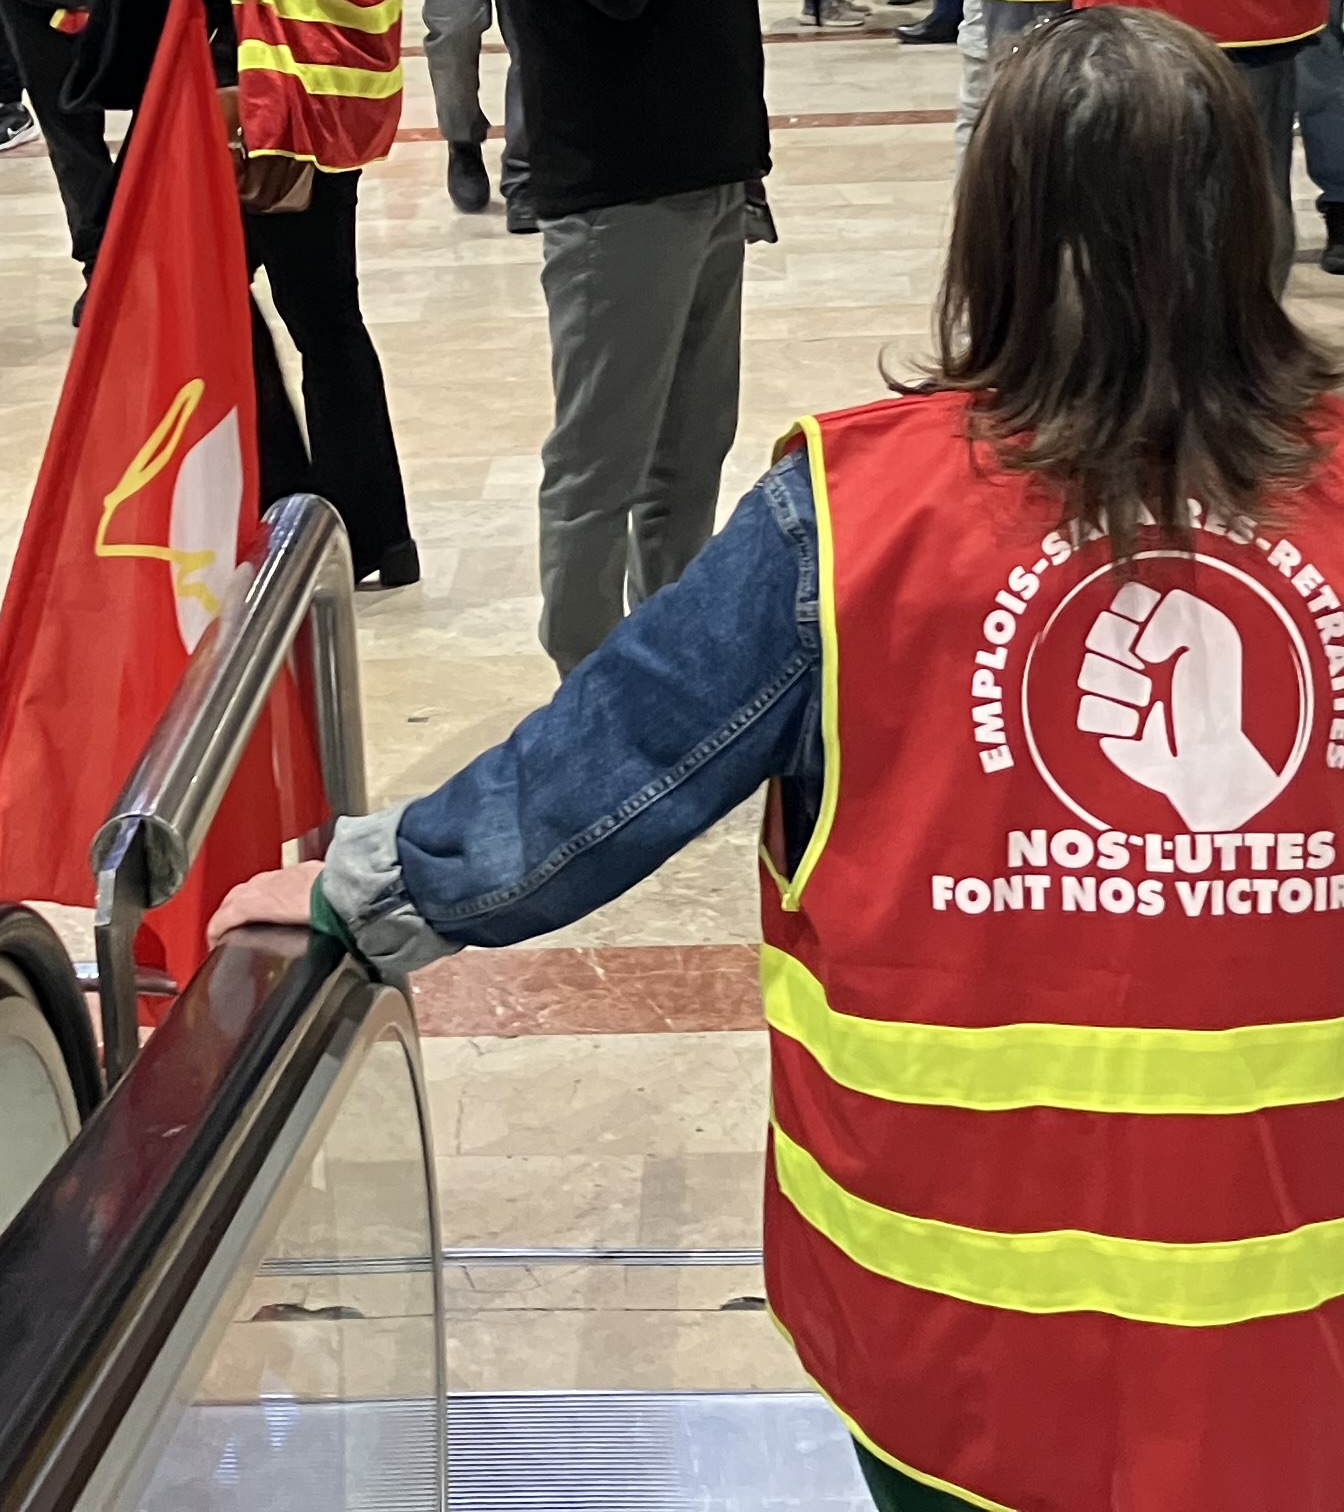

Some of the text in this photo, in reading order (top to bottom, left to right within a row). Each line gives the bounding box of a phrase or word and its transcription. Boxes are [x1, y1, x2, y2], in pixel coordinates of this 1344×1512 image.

[1008, 828, 1336, 874] NOS LUTTES
[931, 874, 1051, 915] FONT
[1062, 876, 1166, 916] NOS
